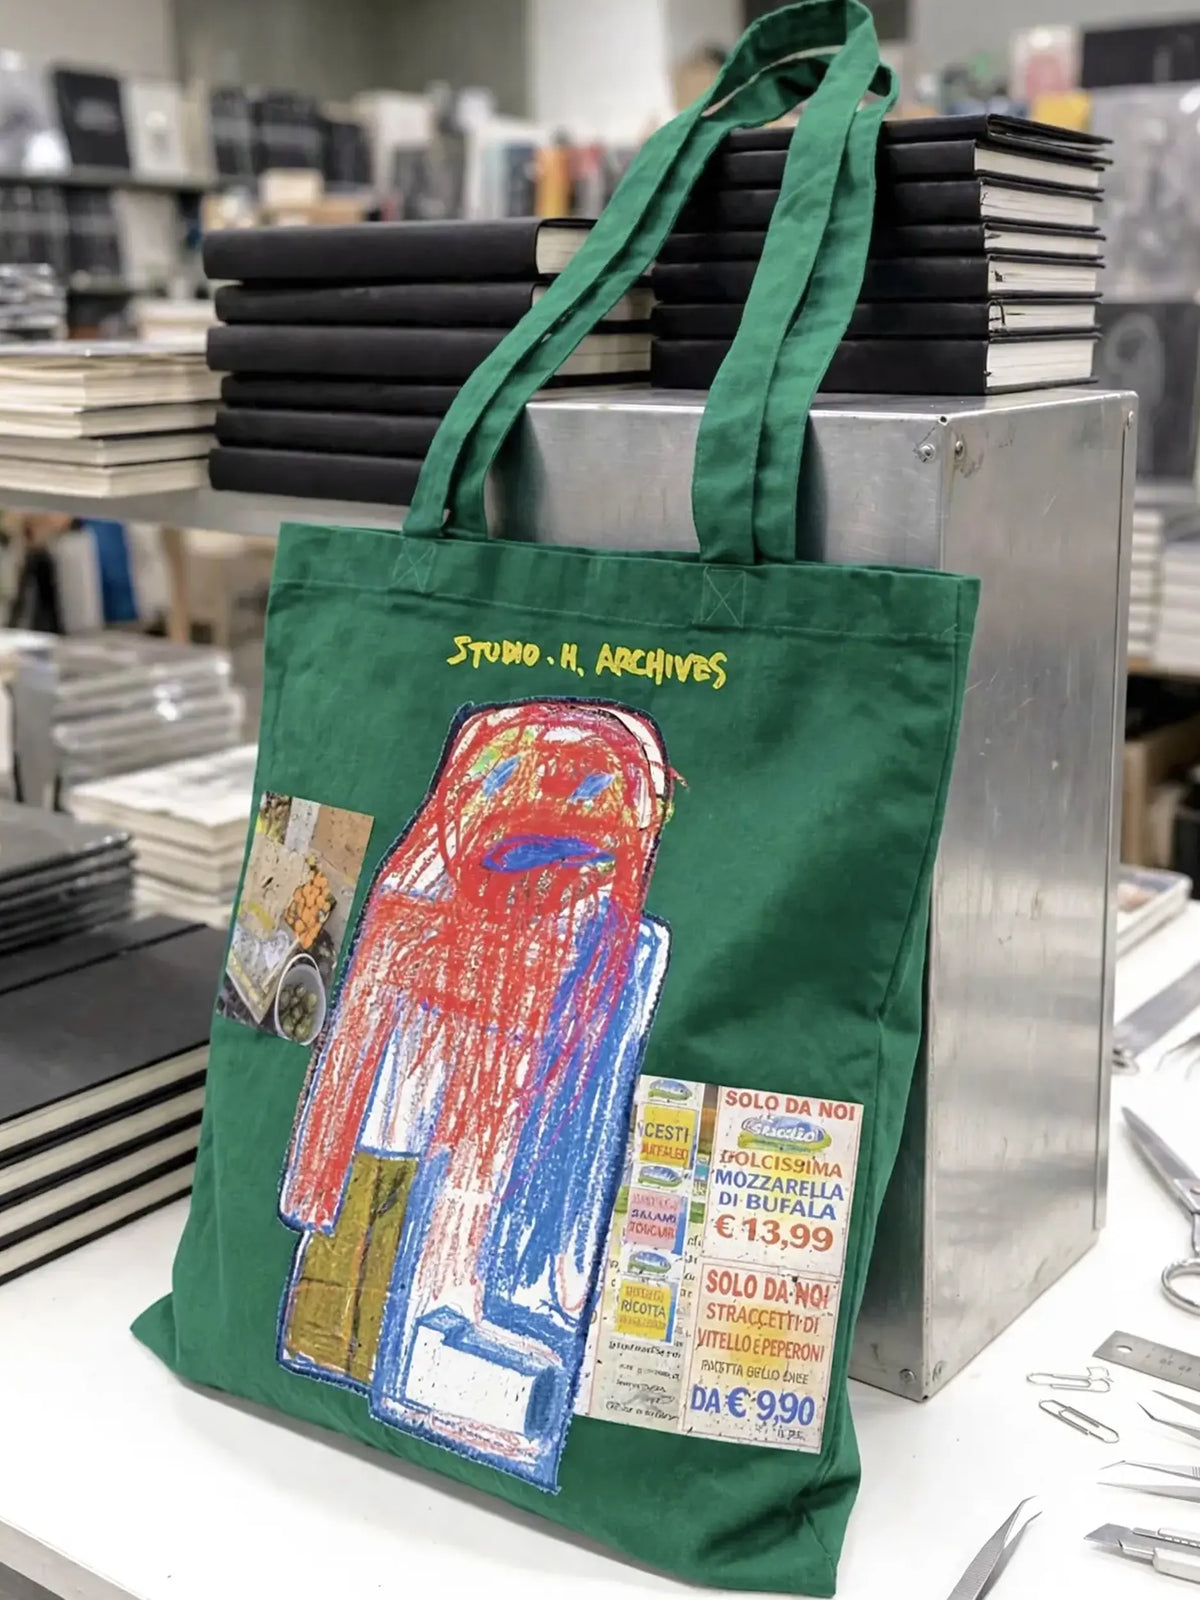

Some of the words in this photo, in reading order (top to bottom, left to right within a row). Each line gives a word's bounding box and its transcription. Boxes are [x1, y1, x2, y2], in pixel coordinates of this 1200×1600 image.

[595, 643, 728, 690] ARCHIVES
[725, 1089, 780, 1112] SOLO
[785, 1097, 812, 1117] DA
[818, 1102, 856, 1121] NOI
[715, 1169, 845, 1201] MOZZARELLA
[718, 1191, 738, 1207] DI
[746, 1193, 837, 1220] BUFALA
[742, 1217, 834, 1253] 13,99
[706, 1269, 758, 1299] SOLO
[763, 1276, 789, 1304] DA
[620, 1299, 667, 1320] RICOTTA
[706, 1302, 800, 1331] STRACCETTI
[803, 1316, 820, 1334] DI
[698, 1327, 752, 1353] VITELLO
[761, 1337, 825, 1363] PEPERONI
[690, 1384, 721, 1414] DA
[756, 1389, 816, 1427] 9,90
